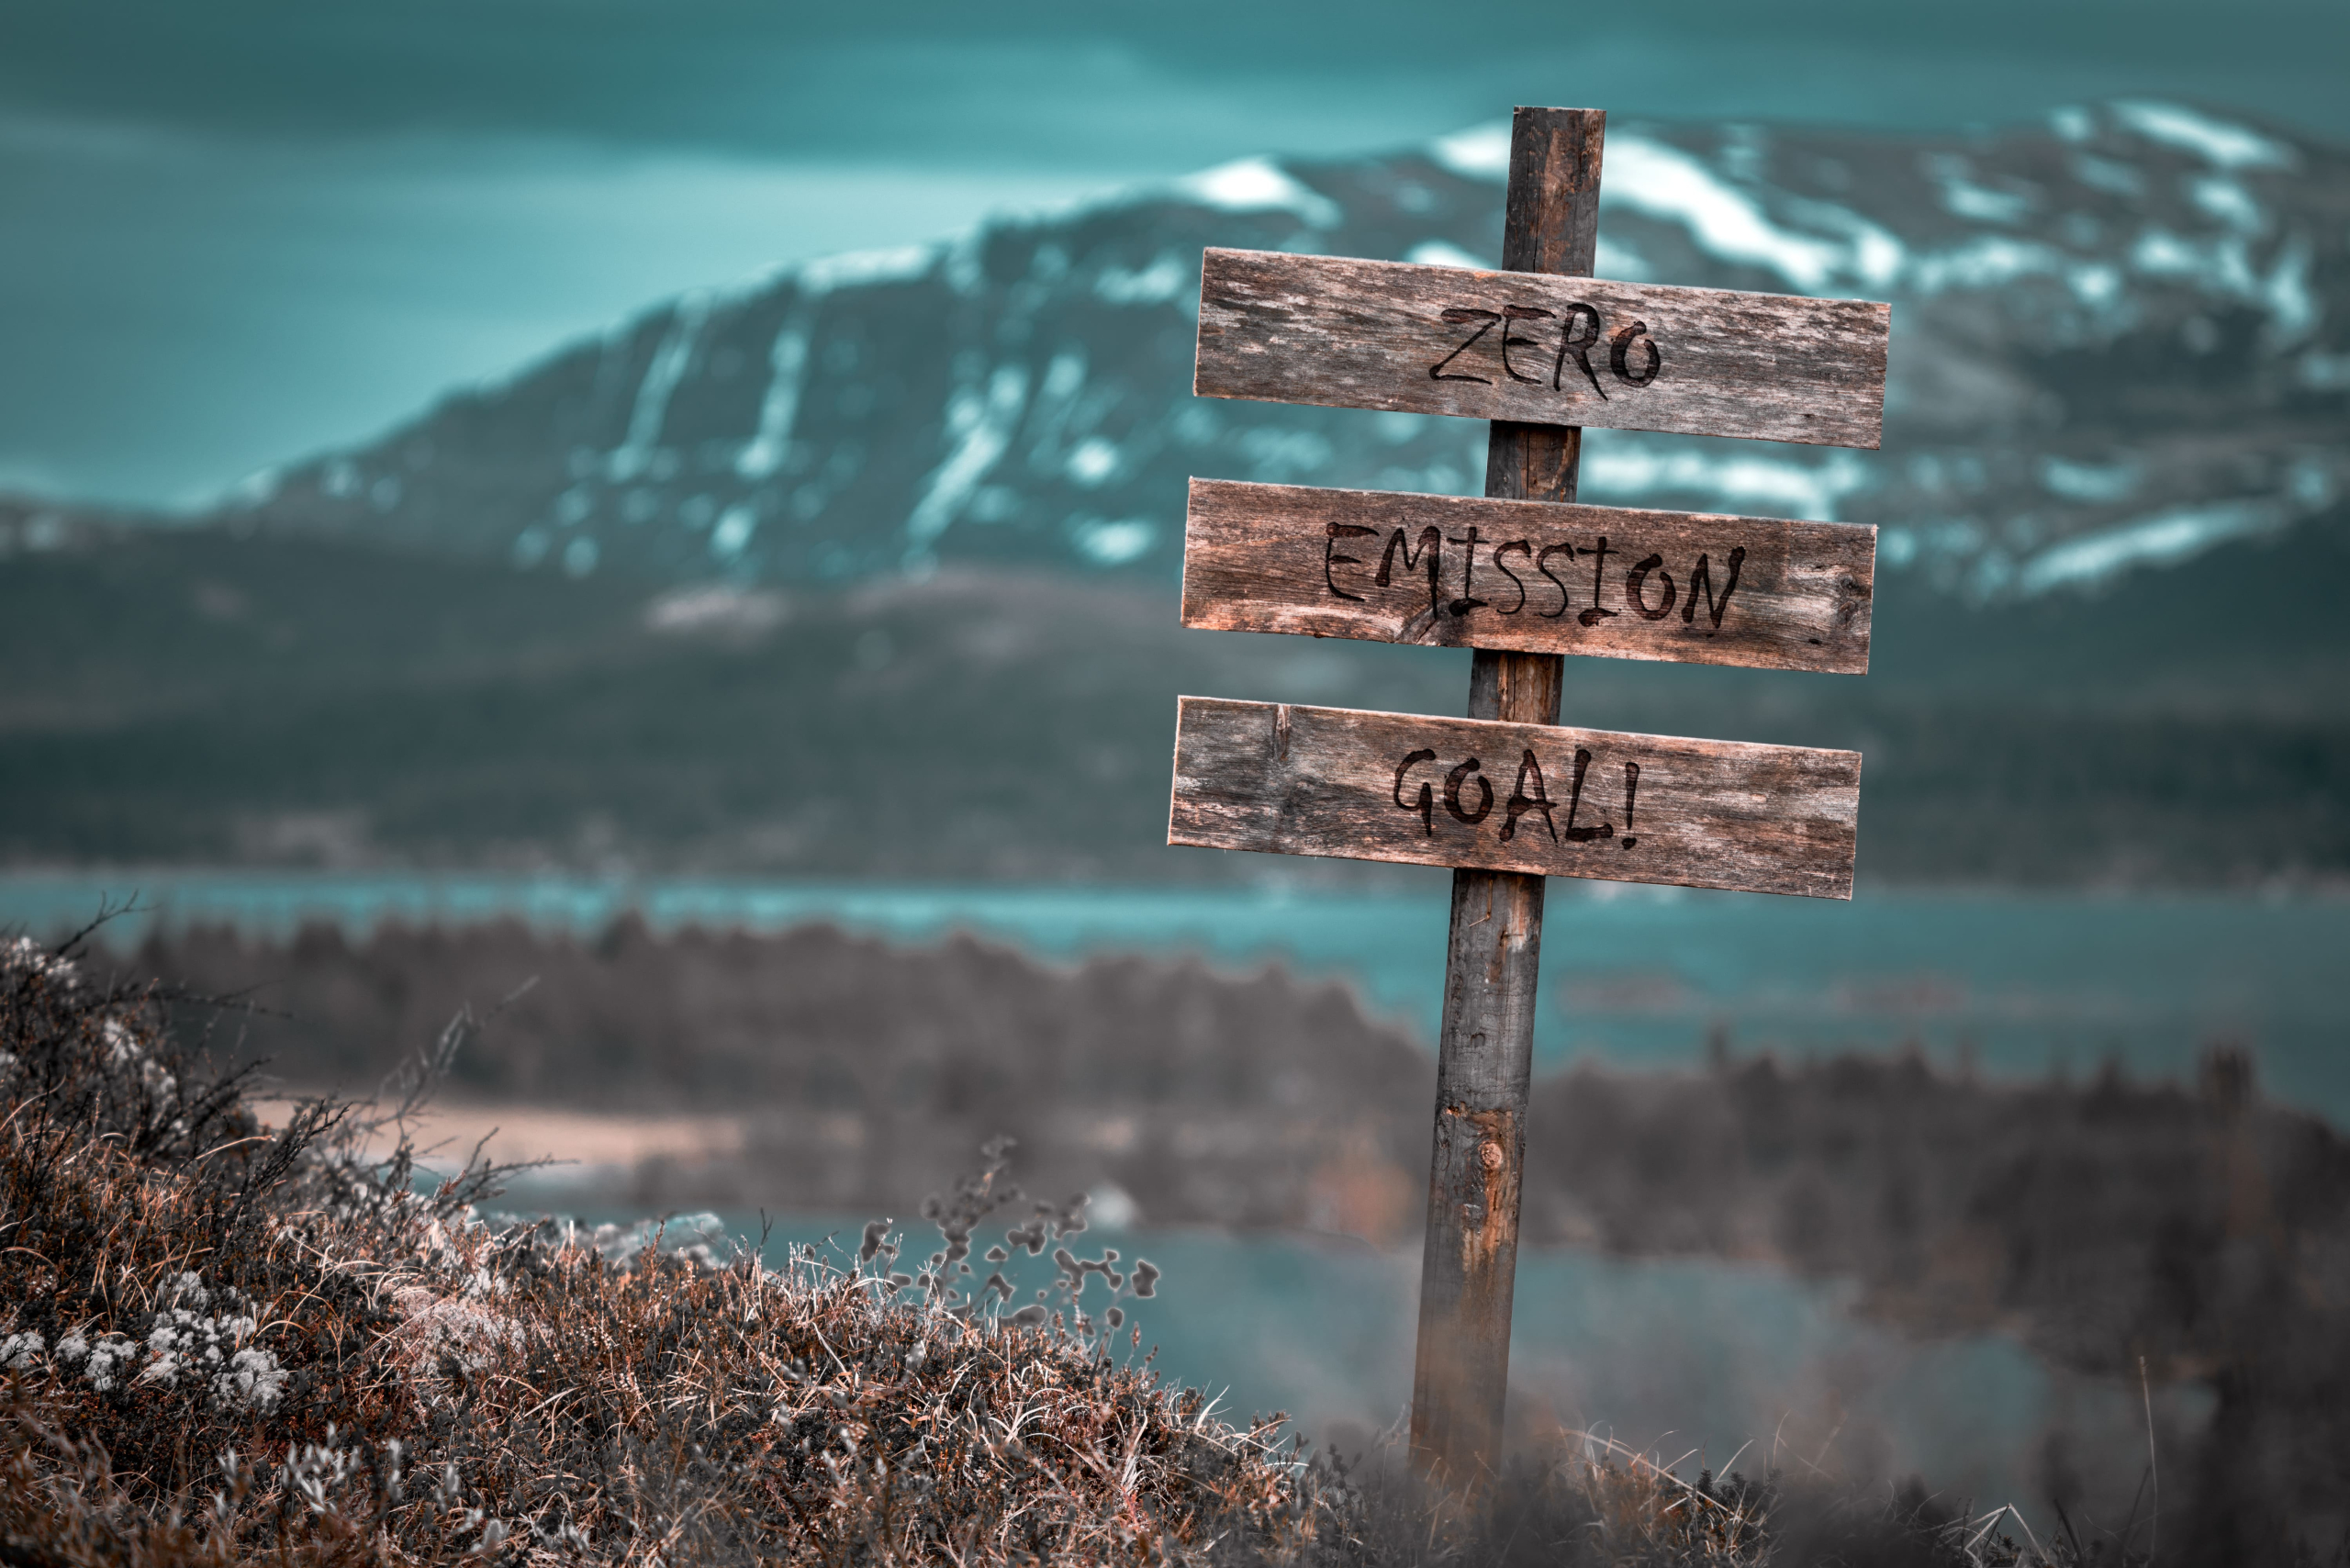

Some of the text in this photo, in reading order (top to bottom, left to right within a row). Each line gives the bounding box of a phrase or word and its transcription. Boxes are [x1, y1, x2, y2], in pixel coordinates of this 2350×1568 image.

[1429, 303, 1661, 400] ZERO
[1326, 522, 1744, 628] EMISSION
[1393, 748, 1639, 849] GOAL!
